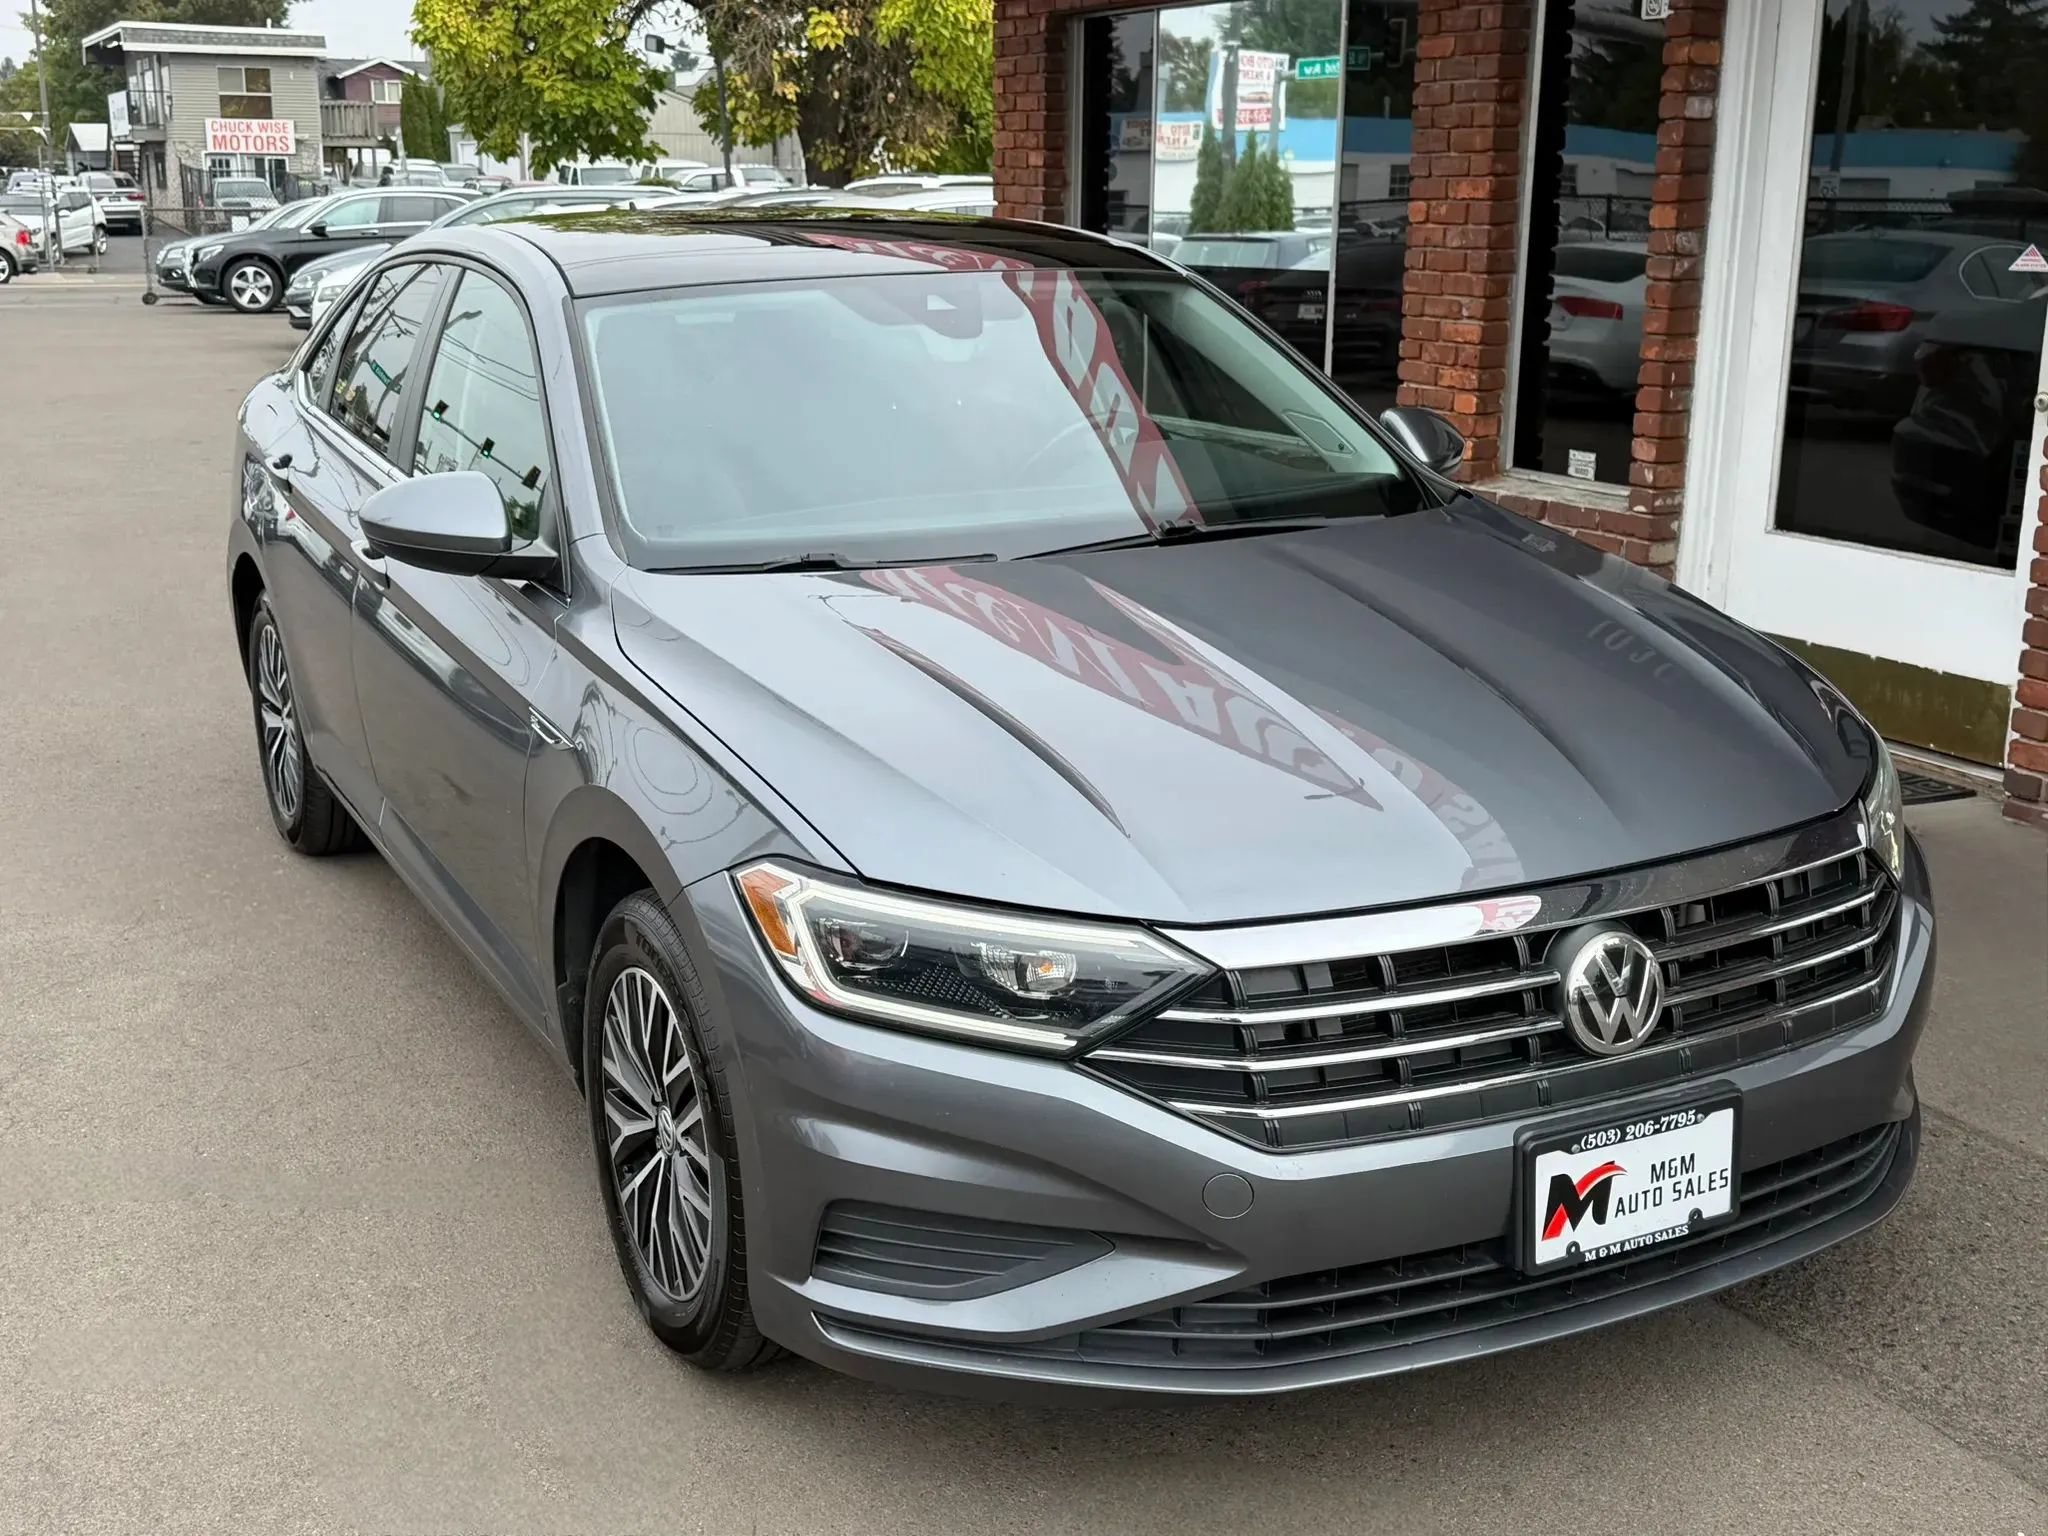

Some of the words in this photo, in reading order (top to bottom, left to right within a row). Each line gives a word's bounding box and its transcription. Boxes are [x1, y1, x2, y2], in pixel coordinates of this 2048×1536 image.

[211, 121, 253, 133] CHUCK
[257, 122, 289, 134] WISE
[212, 135, 289, 152] MOTORS
[1581, 1129, 1621, 1151] (503)
[1625, 1109, 1696, 1142] 206-7795
[1649, 1153, 1696, 1184] M&M
[1615, 1186, 1663, 1218] AUTO
[1672, 1168, 1729, 1202] SALES
[1584, 1250, 1597, 1262] M
[1598, 1247, 1608, 1257] &
[1609, 1243, 1622, 1256] M
[1623, 1235, 1653, 1251] AUTO
[1654, 1225, 1689, 1244] SALES
